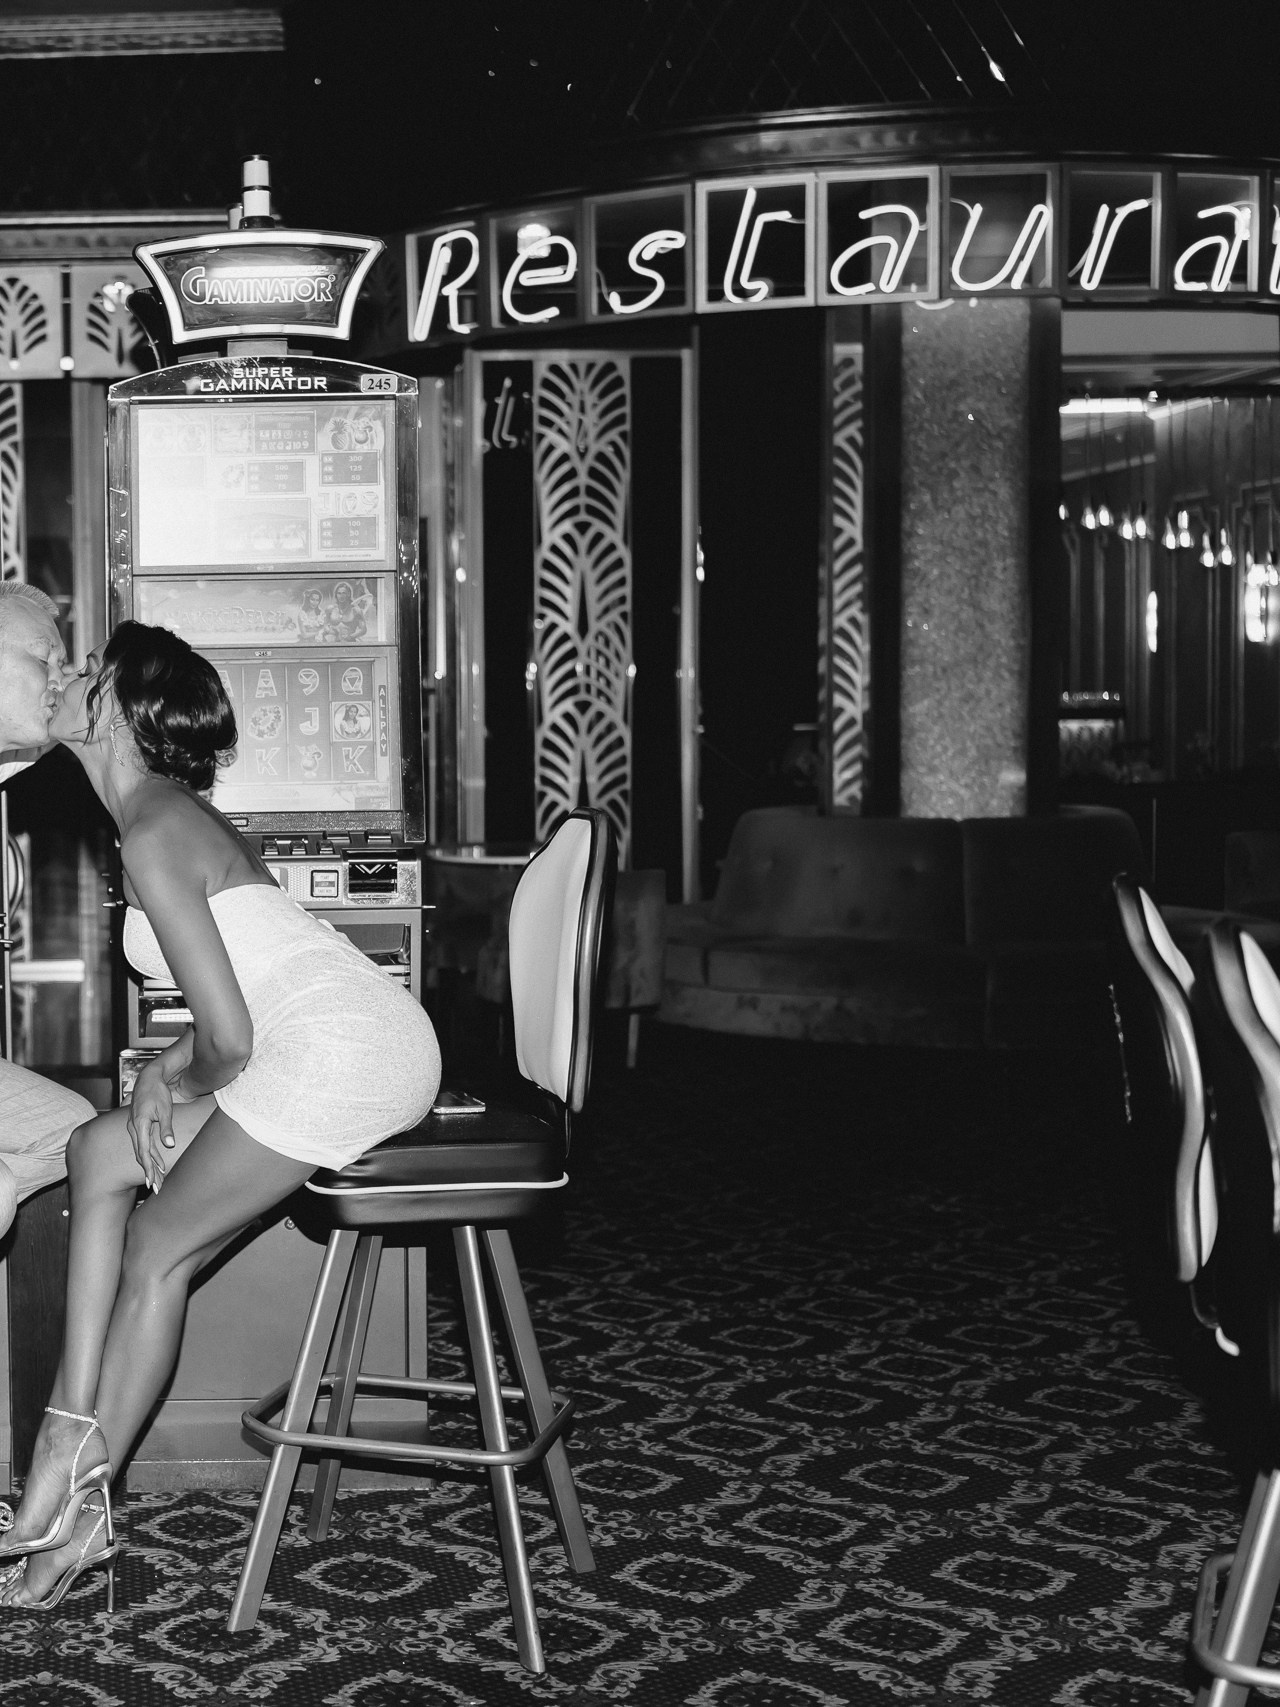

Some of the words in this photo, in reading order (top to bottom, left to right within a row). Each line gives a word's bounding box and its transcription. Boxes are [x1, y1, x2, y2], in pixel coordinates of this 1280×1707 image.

[413, 186, 1280, 342] Restaura
[233, 367, 293, 378] SUPER
[200, 377, 328, 392] GAMINATOR
[367, 377, 392, 391] 245
[298, 668, 319, 696] 9
